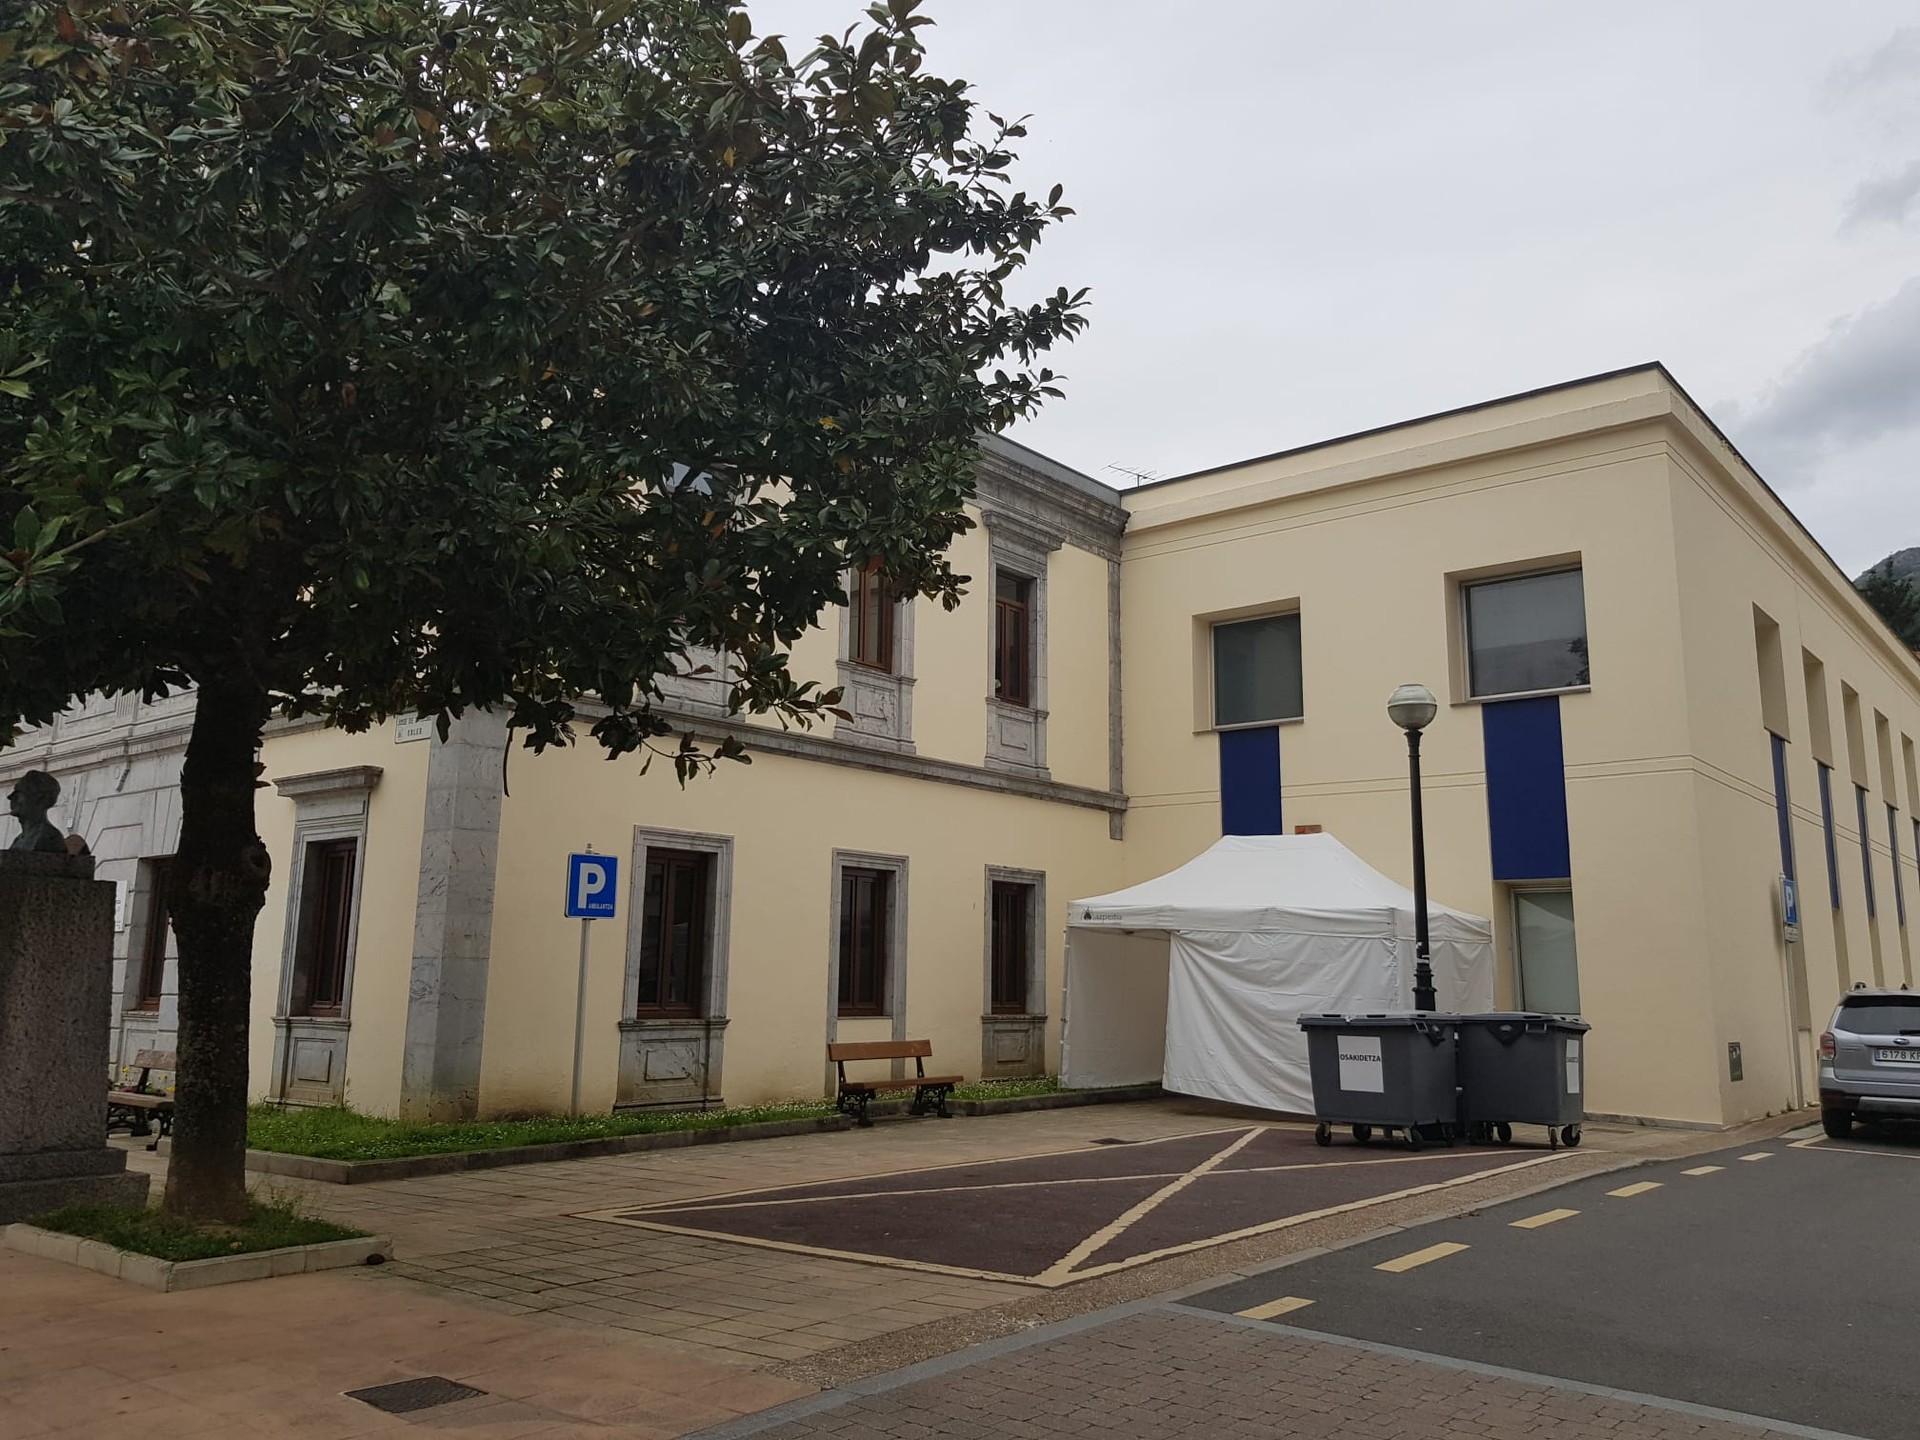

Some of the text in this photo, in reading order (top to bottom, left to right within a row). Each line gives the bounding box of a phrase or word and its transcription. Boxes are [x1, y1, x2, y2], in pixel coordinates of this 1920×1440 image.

[577, 862, 606, 909] P
[1785, 885, 1794, 918] P
[1339, 1053, 1381, 1062] OSAKIDETZA
